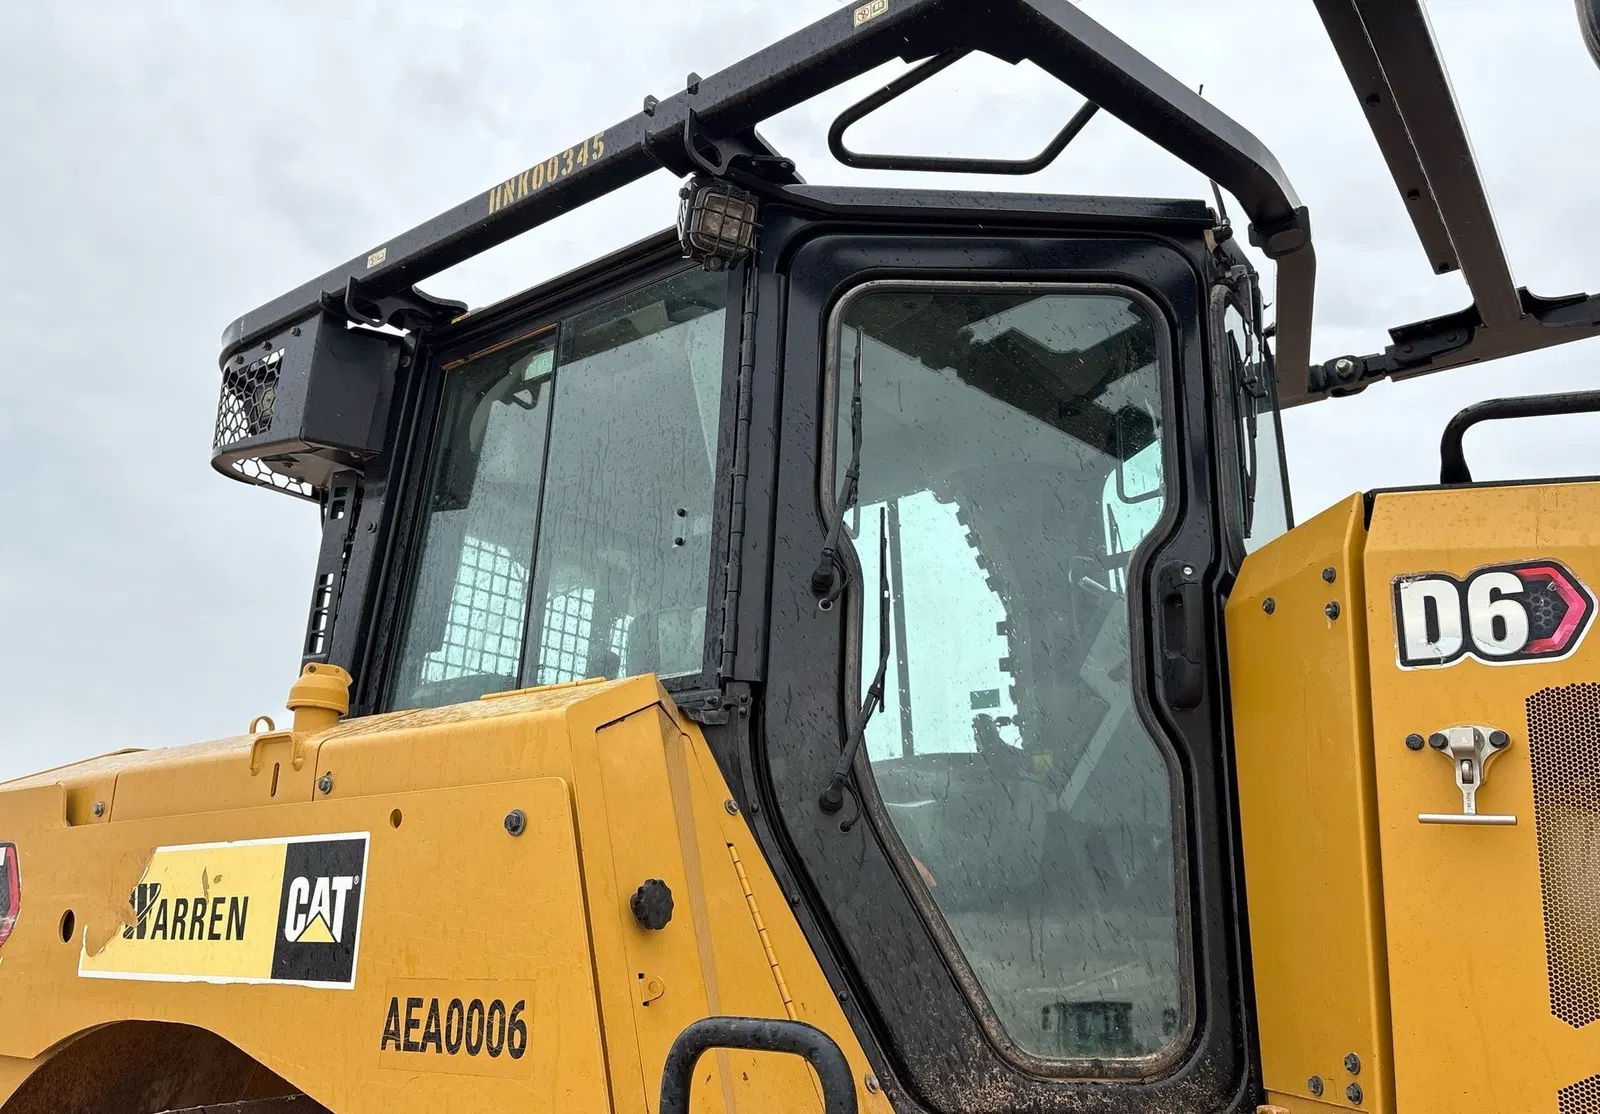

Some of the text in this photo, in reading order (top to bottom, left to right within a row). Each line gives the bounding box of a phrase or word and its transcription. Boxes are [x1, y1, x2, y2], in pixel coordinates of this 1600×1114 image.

[1400, 571, 1529, 660] D6
[284, 875, 354, 943] CAT
[380, 996, 528, 1060] AEA0006
